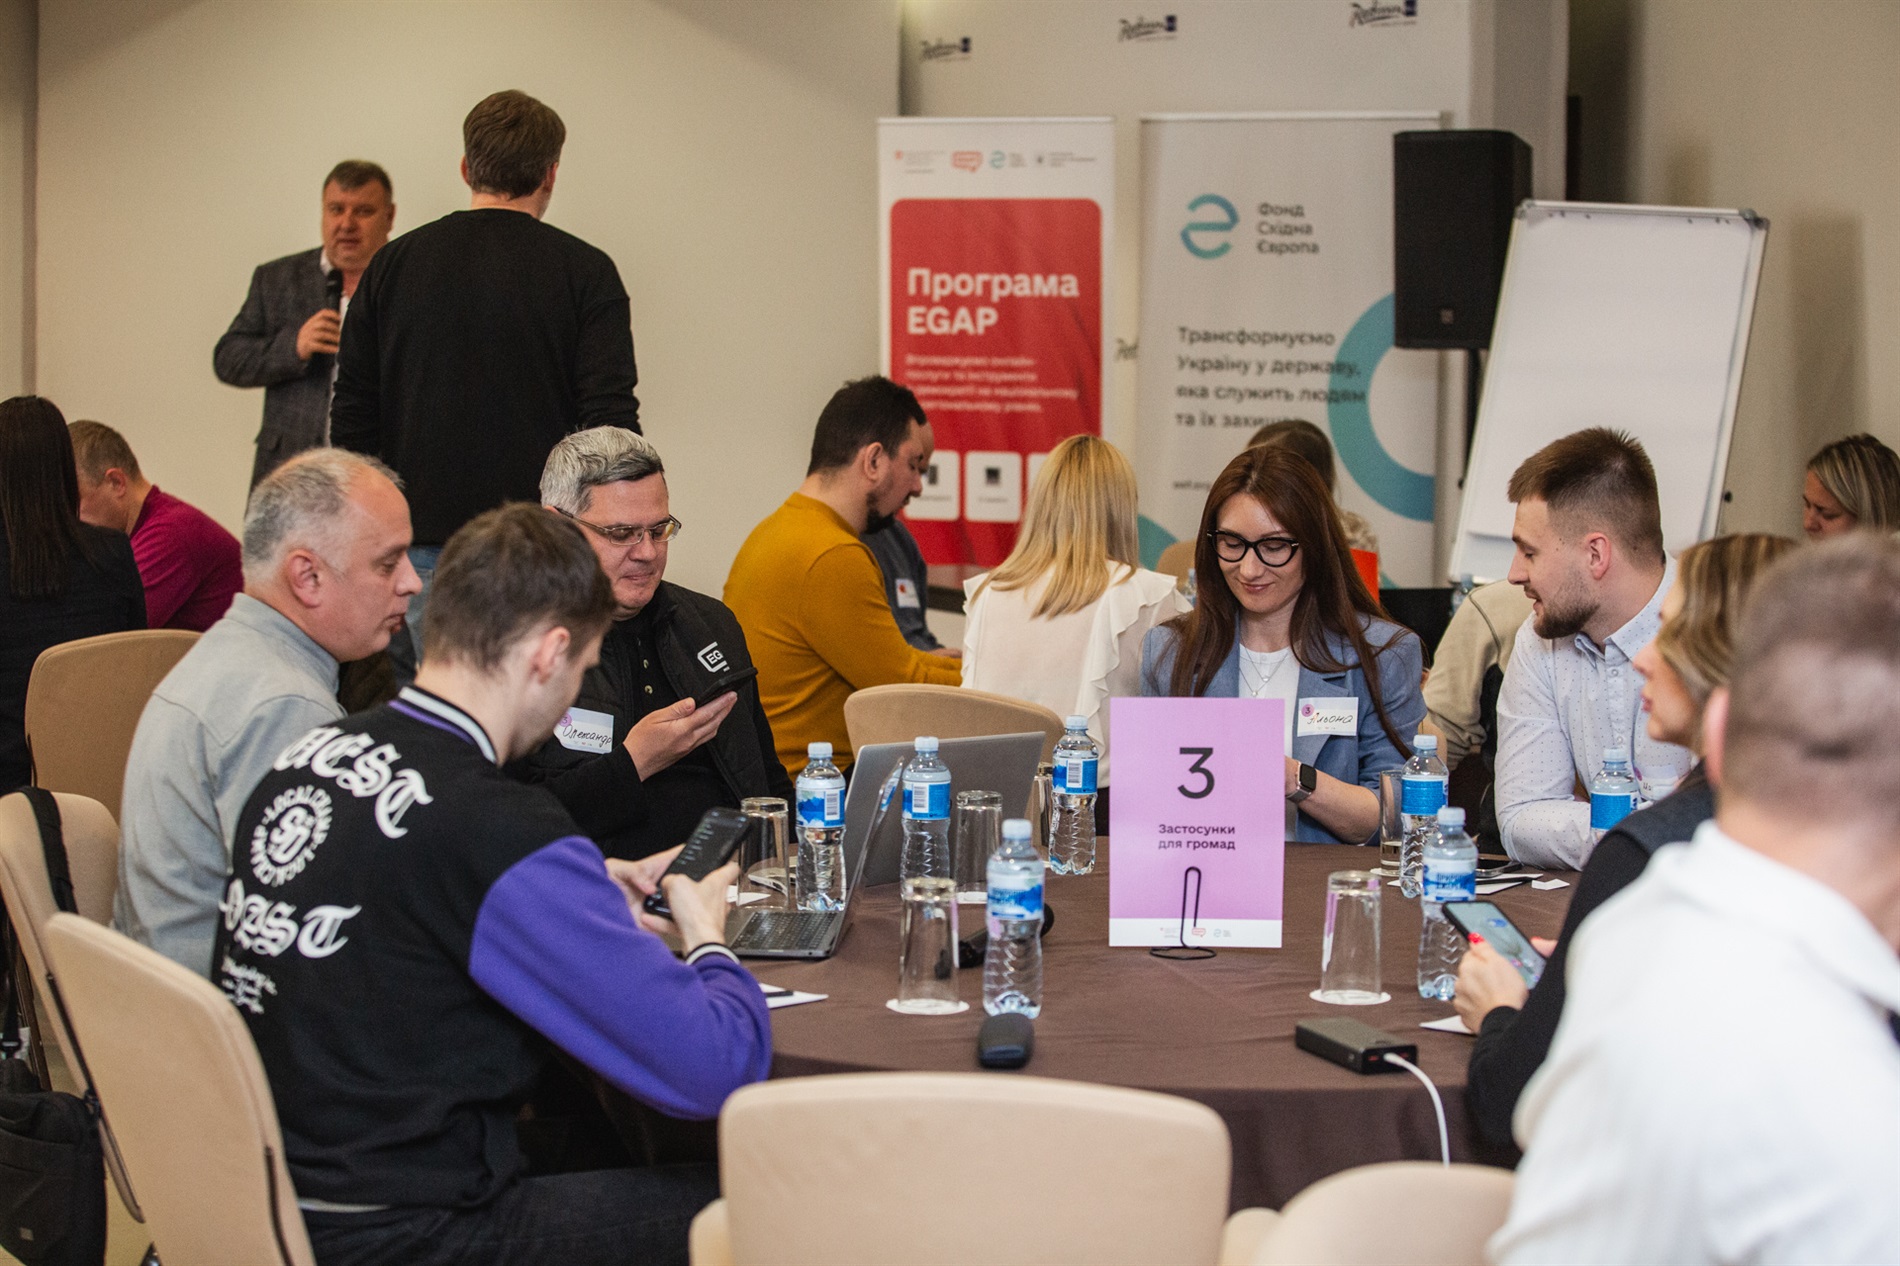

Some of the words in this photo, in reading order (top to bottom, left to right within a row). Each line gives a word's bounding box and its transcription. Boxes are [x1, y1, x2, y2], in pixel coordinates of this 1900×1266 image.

[1258, 202, 1305, 218] Фонд
[1258, 220, 1313, 236] Східна
[1256, 239, 1320, 256] Європа
[907, 268, 1079, 303] Програма
[907, 306, 999, 335] EGAP
[1178, 326, 1336, 348] Трансформуємо
[1177, 354, 1251, 376] Україну
[1256, 361, 1267, 376] у
[1175, 386, 1210, 400] яка
[1214, 387, 1295, 403] служить
[1299, 389, 1367, 404] людям
[1175, 414, 1196, 427] та
[1201, 410, 1216, 427] їх
[706, 650, 724, 665] EG
[562, 723, 613, 748] Олександр
[1177, 747, 1215, 799] 3
[1158, 824, 1236, 836] Застосунки
[1158, 840, 1183, 850] для
[1186, 840, 1236, 851] громад
